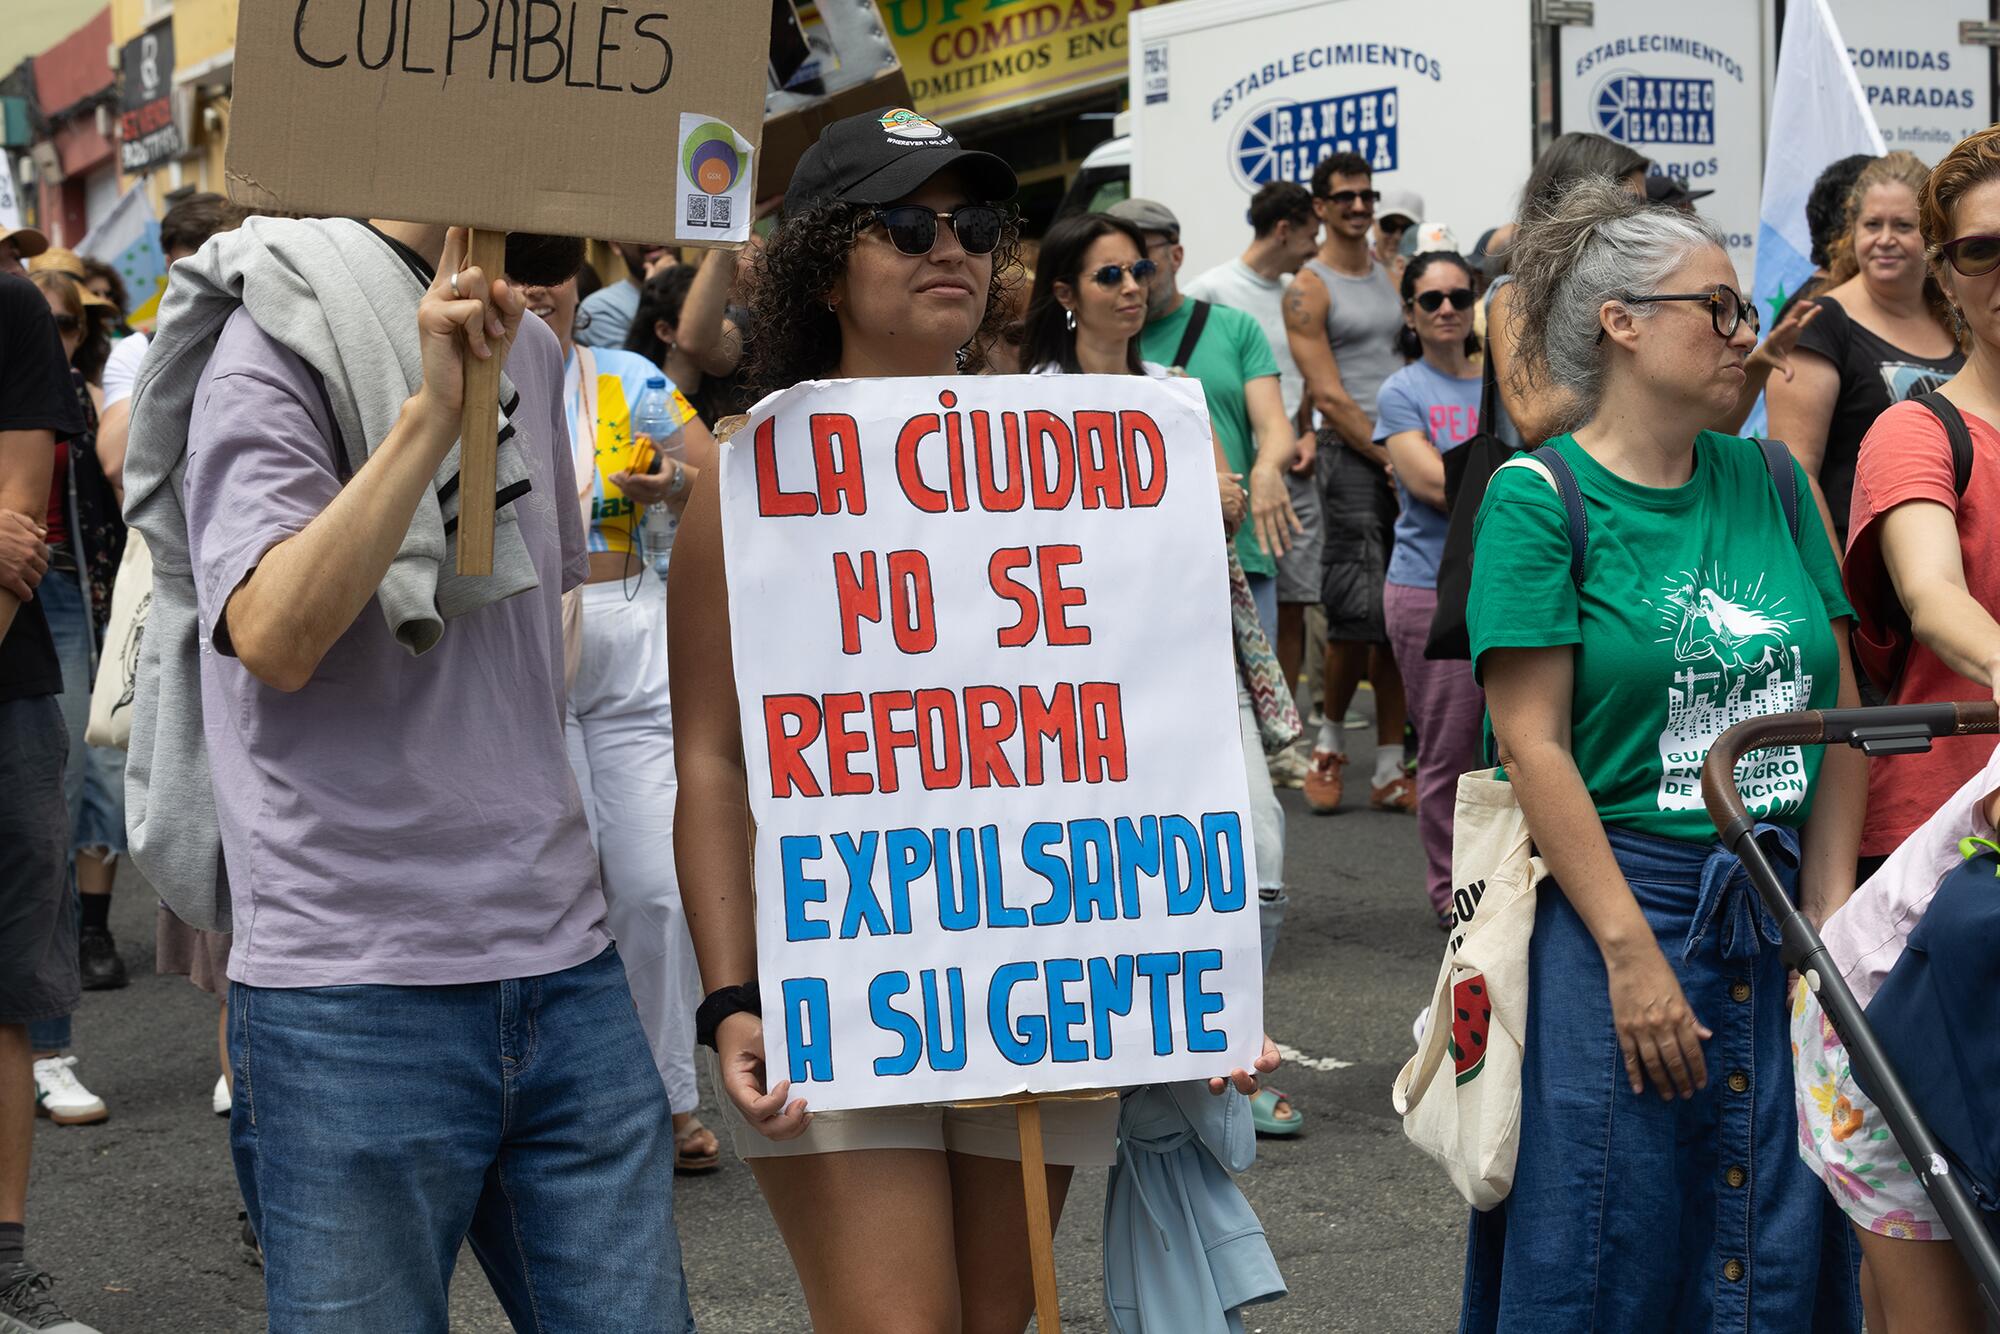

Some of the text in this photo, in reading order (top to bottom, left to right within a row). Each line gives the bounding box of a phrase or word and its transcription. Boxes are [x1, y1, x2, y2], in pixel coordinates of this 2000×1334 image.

[293, 0, 673, 94] CULPABLES
[930, 0, 1117, 66] COMIDAS
[1576, 34, 1744, 83] ESTABLECIMIENTOS
[911, 23, 1127, 100] DMITIMOS ENC
[1212, 43, 1442, 122] ESTABLECIMIENTOS
[1278, 92, 1396, 146] RANCHO
[1628, 80, 1713, 111] RANCHO
[1861, 85, 1974, 108] PARADAS
[1630, 112, 1711, 142] GLORIA
[1650, 157, 1718, 178] ARIOS
[1429, 404, 1479, 442] PEA
[754, 412, 867, 517] LA
[591, 496, 635, 519] ias
[833, 544, 1092, 655] NO SE
[762, 681, 1129, 799] REFORMA
[1664, 779, 1803, 799] DE NCIÓN
[1733, 760, 1799, 783] ELIGRO
[779, 811, 1248, 942] EXPULSANDO
[781, 949, 1229, 1084] A SU GENTE
